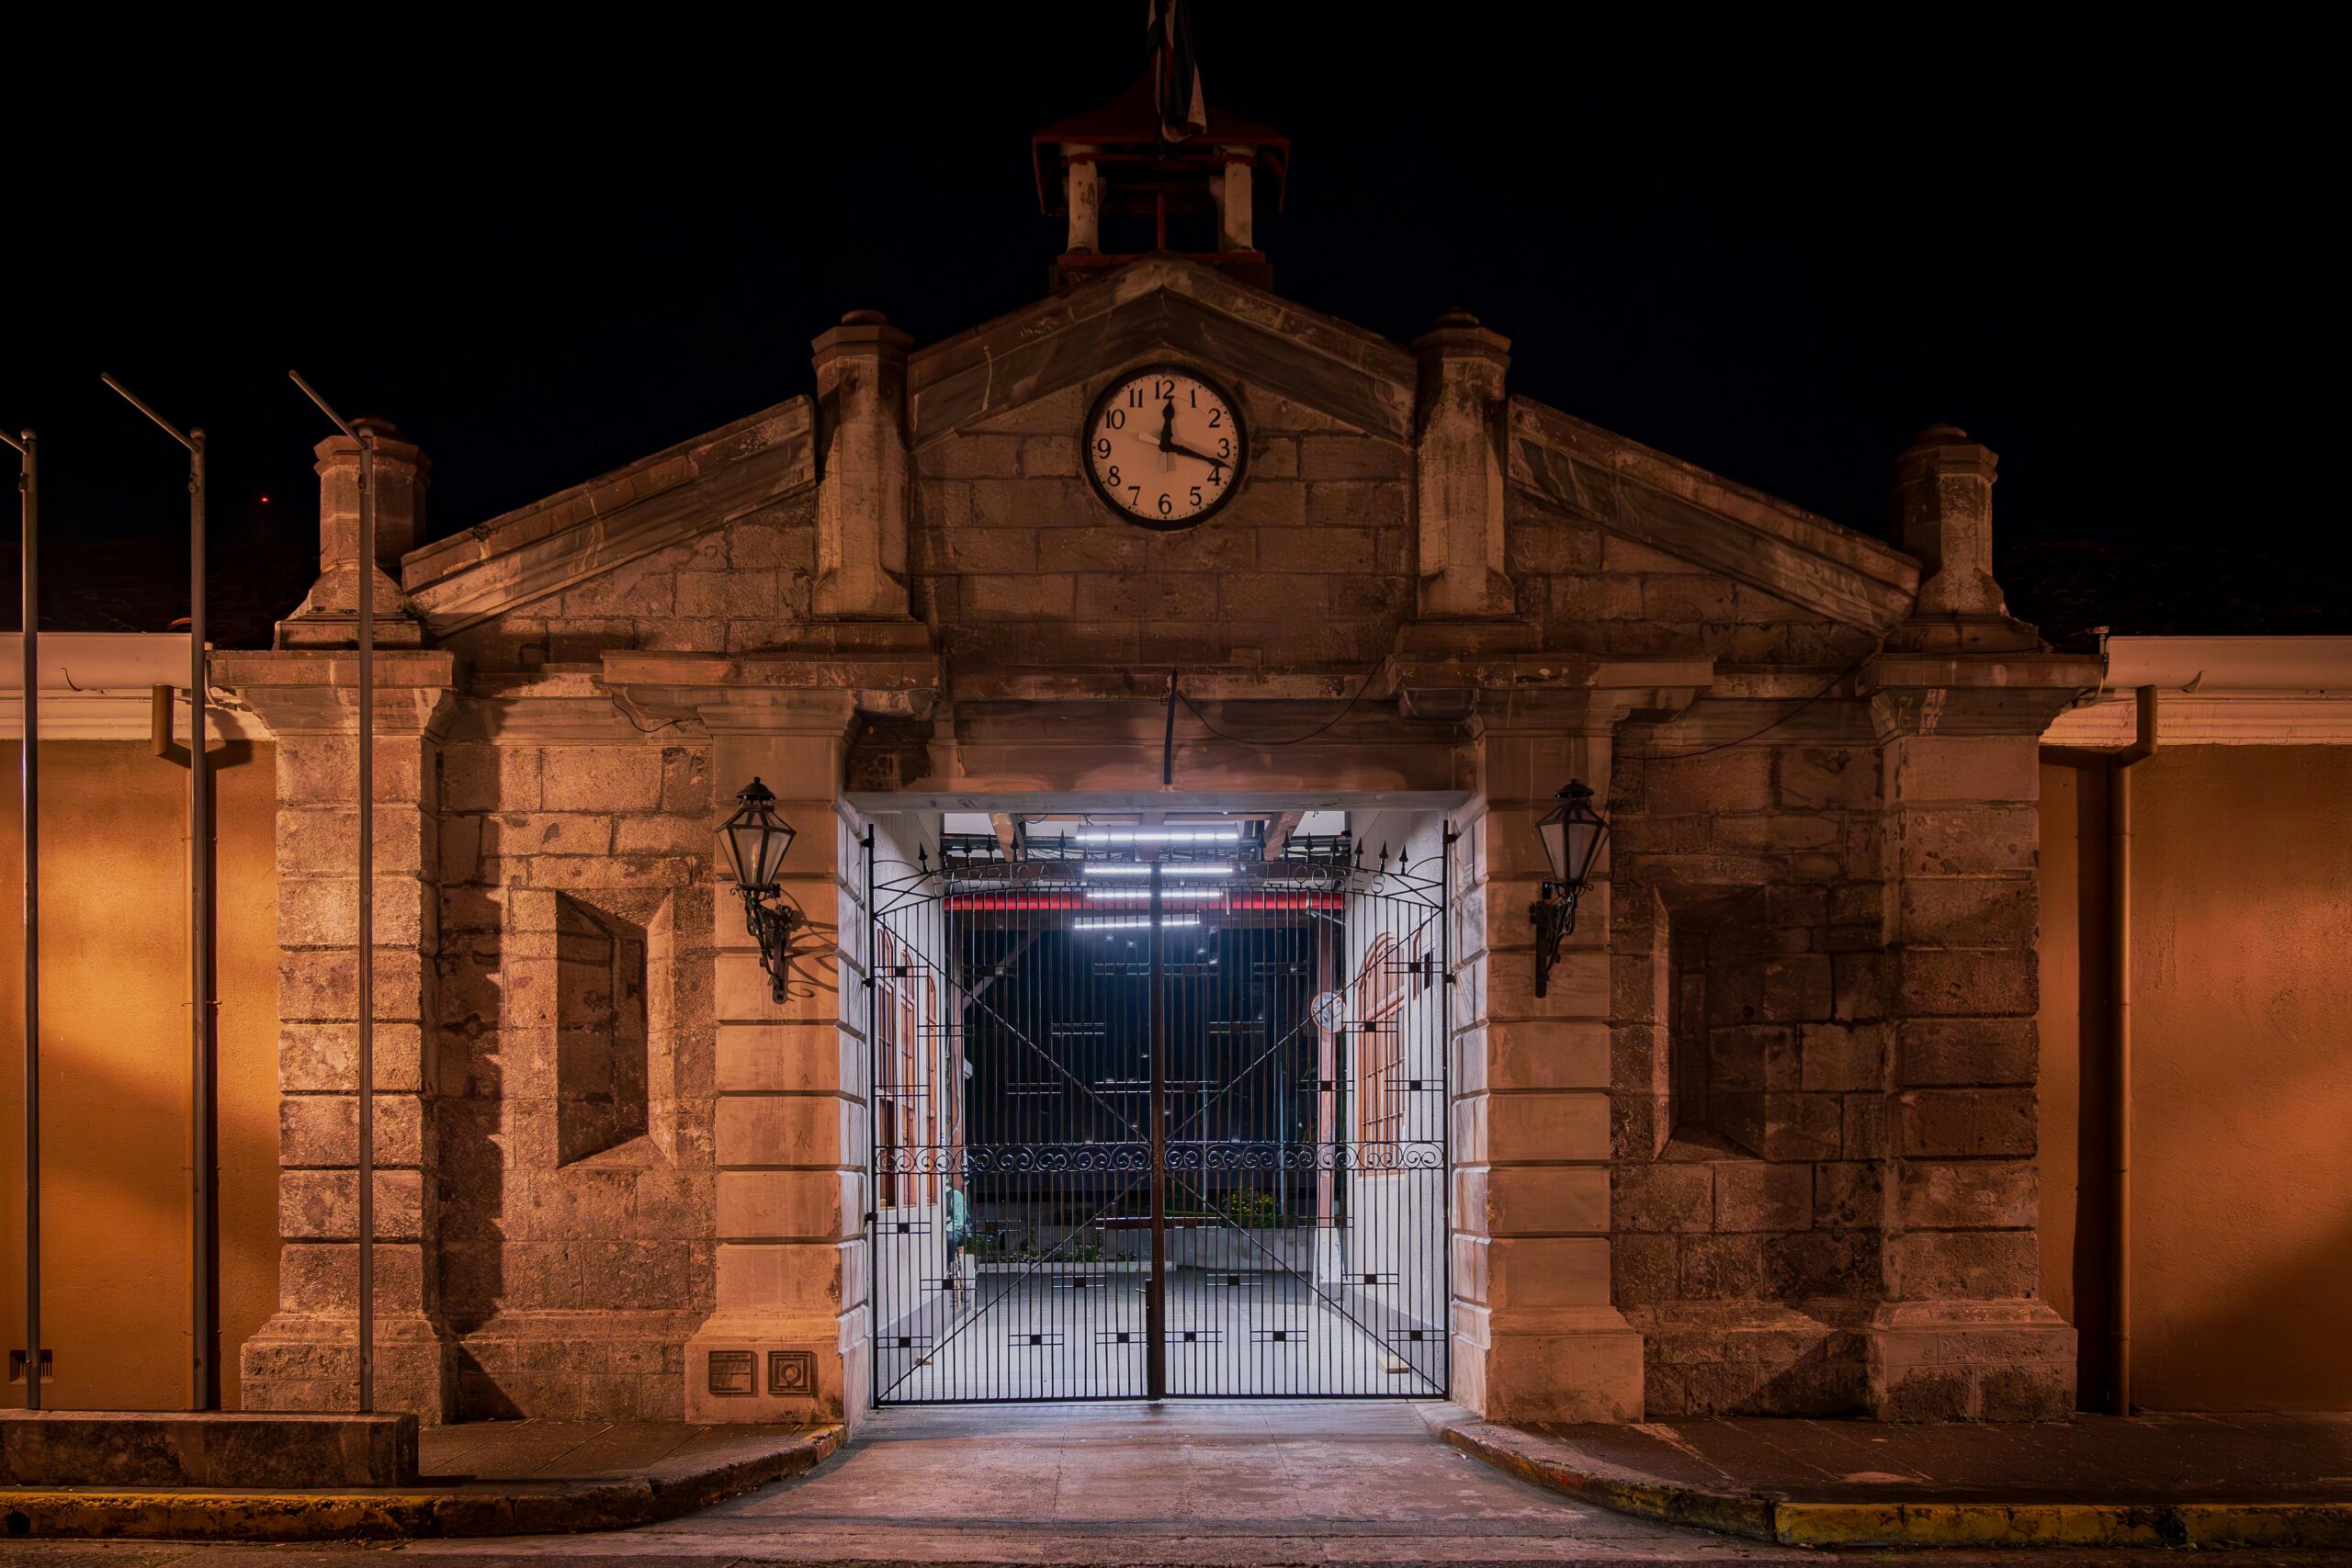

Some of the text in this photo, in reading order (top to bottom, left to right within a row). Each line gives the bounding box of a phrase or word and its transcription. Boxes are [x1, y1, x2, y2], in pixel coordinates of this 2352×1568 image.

[1129, 389, 1143, 408] 11
[1155, 380, 1175, 400] 12
[1191, 389, 1197, 408] 1
[1105, 409, 1125, 430] 10
[1208, 408, 1221, 428] 2
[1097, 438, 1111, 459] 9
[1216, 438, 1230, 459] 3
[1107, 466, 1121, 486] 8
[1206, 466, 1221, 486] 4
[1127, 486, 1141, 506] 7
[1158, 493, 1172, 514] 6
[1189, 486, 1202, 506] 5
[933, 864, 1053, 897] FABRICA
[1266, 862, 1386, 894] LICORES
